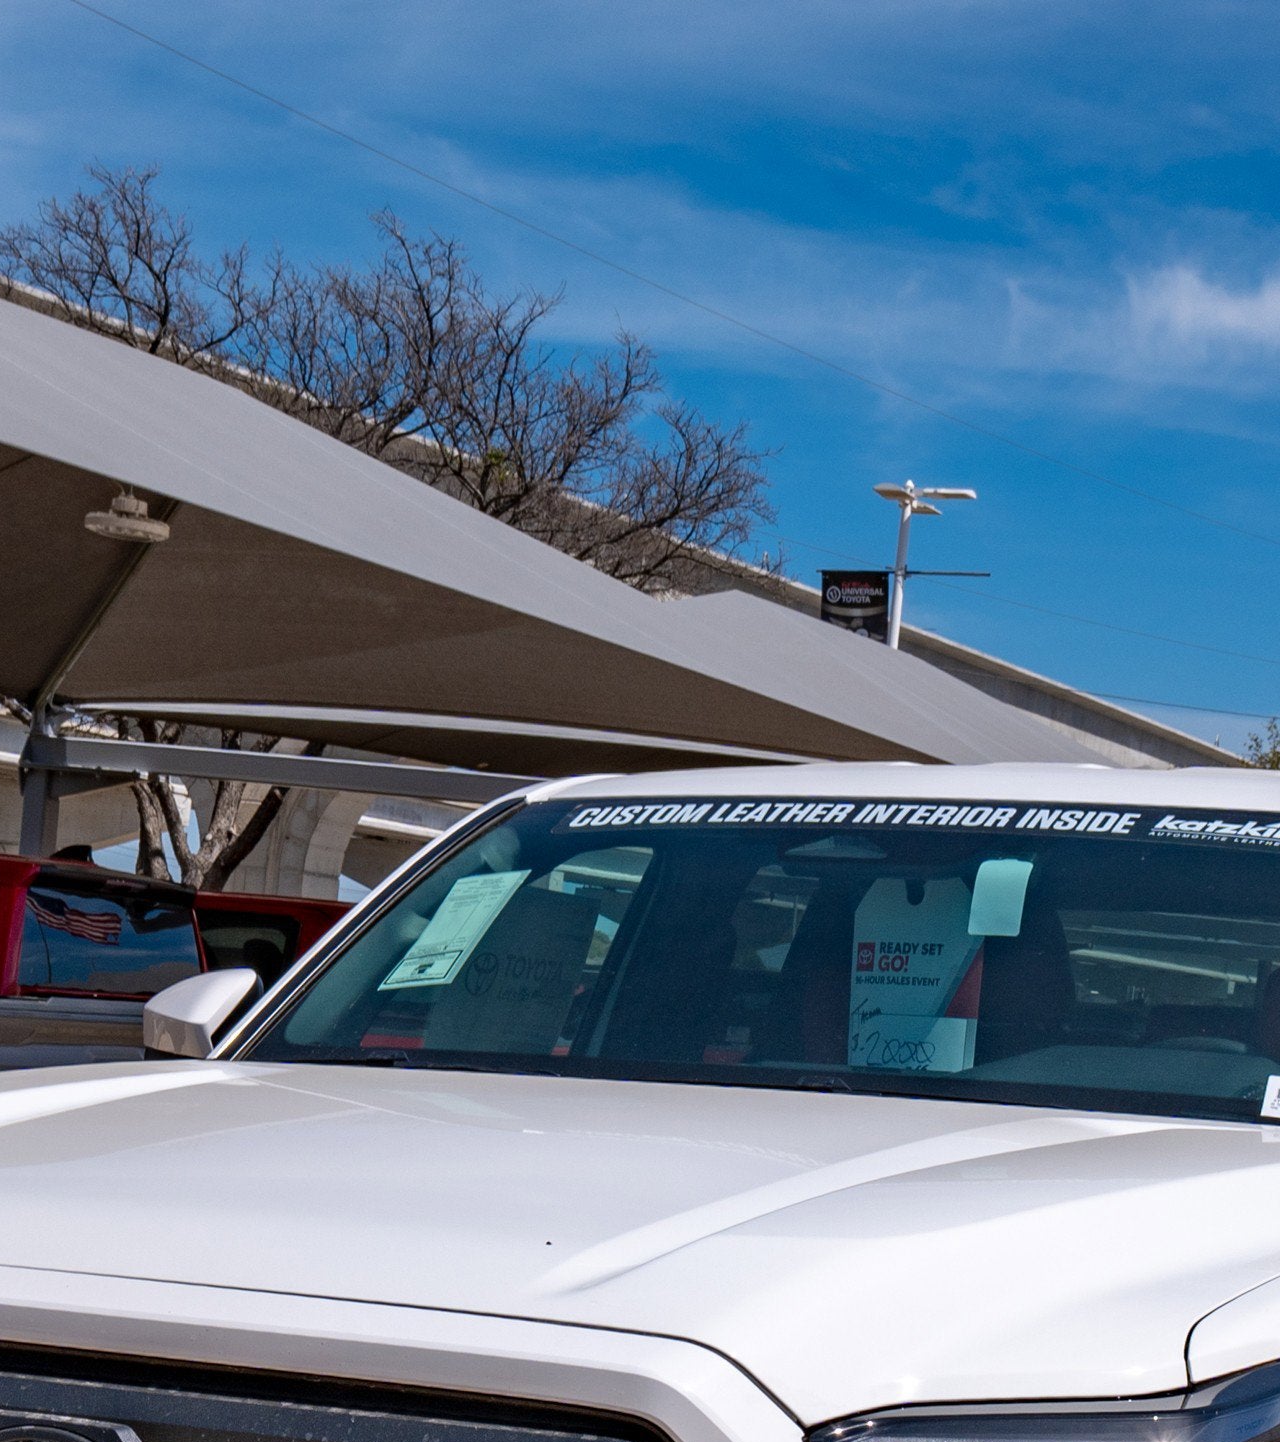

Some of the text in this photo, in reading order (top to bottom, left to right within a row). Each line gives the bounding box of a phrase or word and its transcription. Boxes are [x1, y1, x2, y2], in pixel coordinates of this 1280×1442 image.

[841, 587, 884, 596] UNIVERSAL
[841, 595, 871, 604] TOYOTA
[569, 802, 1142, 834] CUSTOM LEATHER INTERIOR INSIDE
[1148, 831, 1228, 842] AUTOMOTIVE
[879, 941, 945, 956] READY SET
[877, 955, 910, 972] GO!
[886, 976, 911, 986] SALES
[911, 976, 941, 986] EVENT
